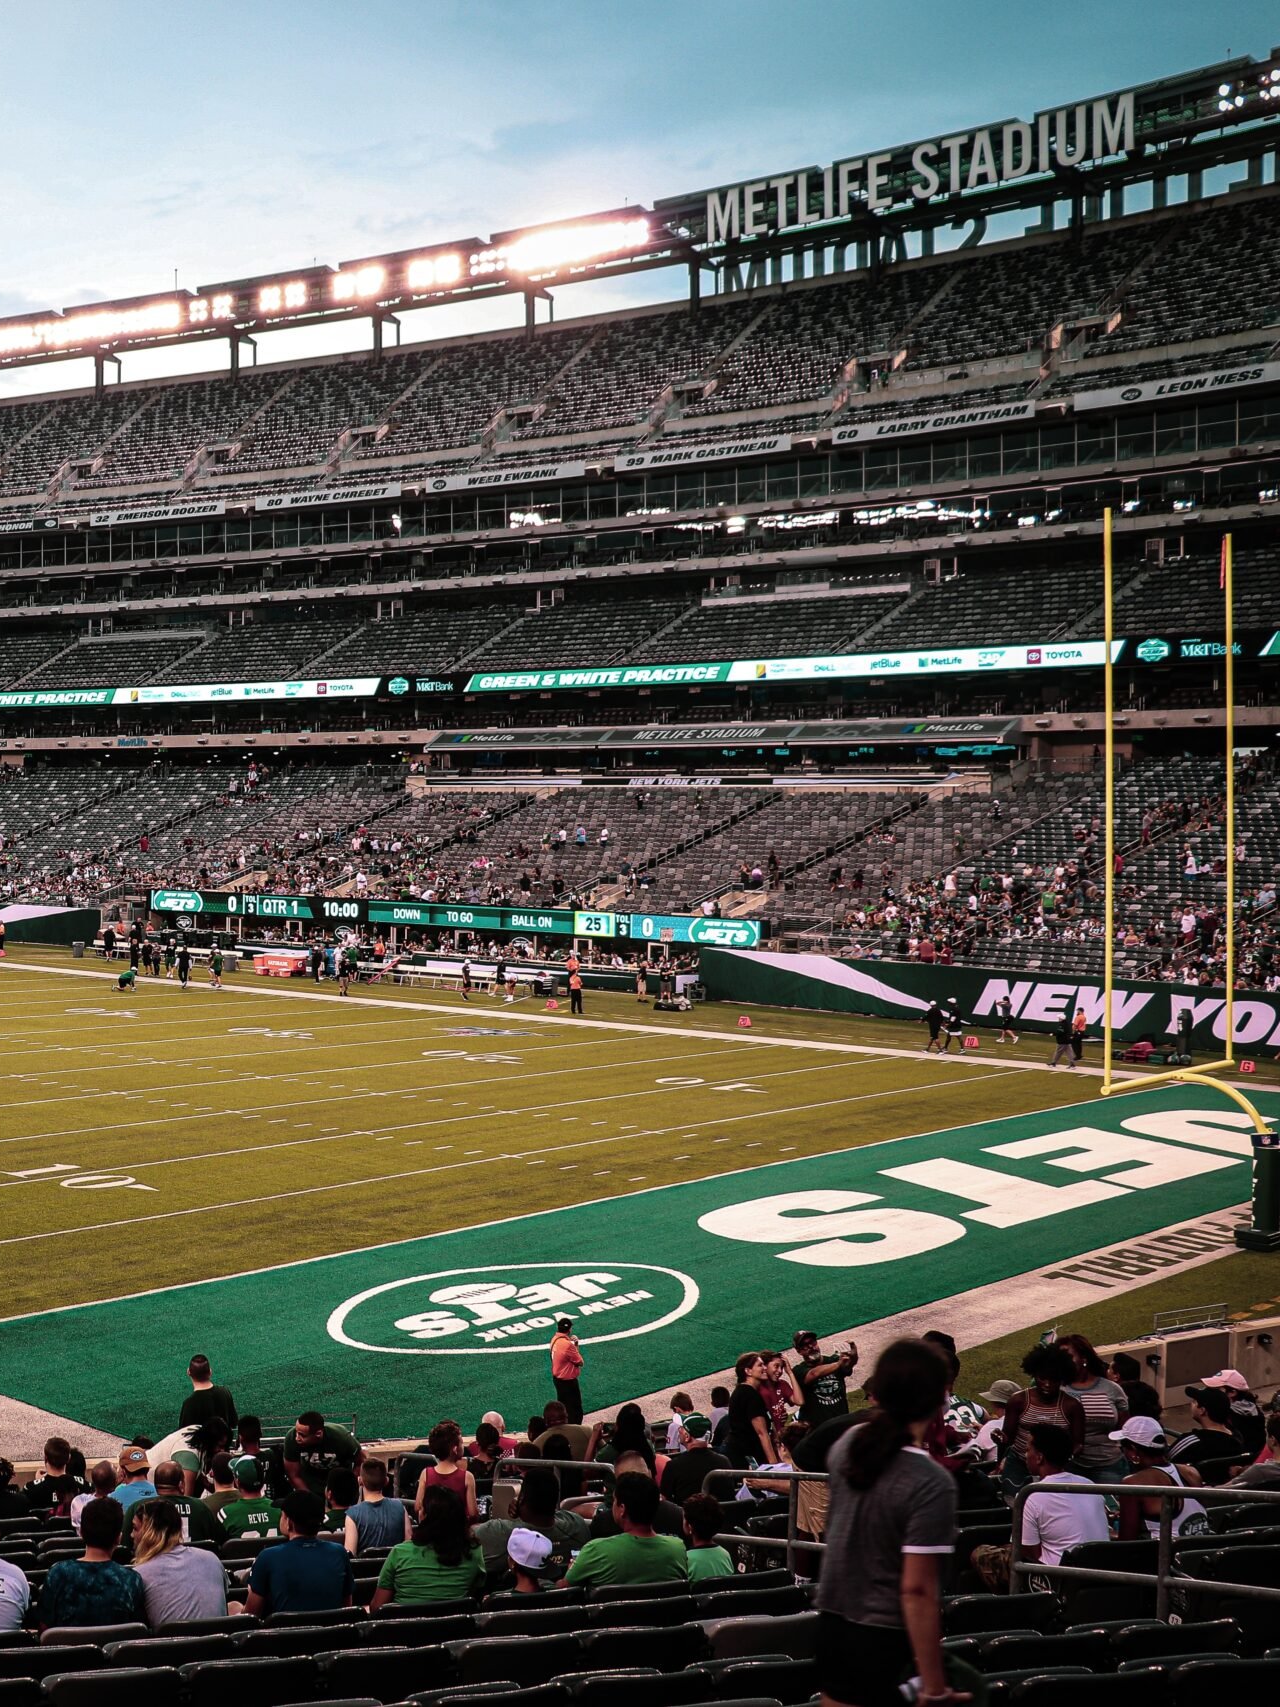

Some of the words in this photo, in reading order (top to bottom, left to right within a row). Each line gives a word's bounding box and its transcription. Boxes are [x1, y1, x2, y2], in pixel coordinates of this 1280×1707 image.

[706, 153, 892, 242] METLIFE
[912, 92, 1135, 199] STADIUM
[1155, 378, 1208, 396] LEON
[1210, 368, 1264, 387] HESS
[837, 429, 858, 439] 60
[876, 420, 930, 435] LARRY
[932, 405, 1030, 427] GRANTHAM
[626, 457, 644, 466] 99
[650, 452, 694, 464] MARK
[696, 439, 779, 458] GASTINEAU
[467, 475, 502, 485] WEEB
[504, 468, 558, 482] EWBANK
[266, 498, 282, 506] 80
[290, 494, 330, 504] WAYNE
[332, 487, 388, 500] CHREBET
[94, 515, 110, 523] 32
[116, 509, 170, 521] EMERSON
[171, 505, 217, 516] BOOZER
[1045, 650, 1082, 659] TOYOTA
[1181, 644, 1210, 656] M&T
[870, 659, 901, 670] jetBlue
[931, 657, 962, 666] MetLife
[480, 675, 540, 688] GREEN
[542, 674, 556, 686] &
[559, 670, 620, 685] WHITE
[623, 667, 720, 682] PRACTICE
[211, 688, 233, 696] jetBlue
[416, 683, 435, 691] M&T
[435, 682, 453, 691] Bank
[36, 692, 107, 704] PRACTICE
[925, 723, 983, 732] MetLife
[470, 734, 514, 742] MetLife
[632, 729, 697, 740] METLIFE
[697, 728, 767, 739] STADIUM
[118, 738, 148, 747] MetLife
[160, 898, 197, 908] JETS
[228, 896, 237, 912] 0
[248, 903, 254, 913] 3
[262, 900, 287, 914] QTR
[291, 901, 298, 914] 1
[323, 902, 359, 918] 10:00
[393, 908, 421, 919] DOWN
[447, 911, 459, 921] TO
[460, 912, 473, 923] GO
[511, 915, 536, 927] BALL
[538, 916, 552, 928] ON
[616, 915, 630, 923] TOL
[585, 918, 601, 931] 25
[620, 925, 627, 935] 3
[642, 918, 654, 937] 0
[698, 929, 750, 943] JETS
[972, 978, 1156, 1030] NEW
[1164, 994, 1280, 1045] YO
[967, 1037, 975, 1046] 10
[1242, 1061, 1251, 1071] G
[0, 1163, 137, 1189] 10
[393, 1272, 622, 1339] JETS
[578, 1289, 656, 1318] NEW
[473, 1310, 579, 1343] YORK
[247, 1512, 269, 1524] REVIS
